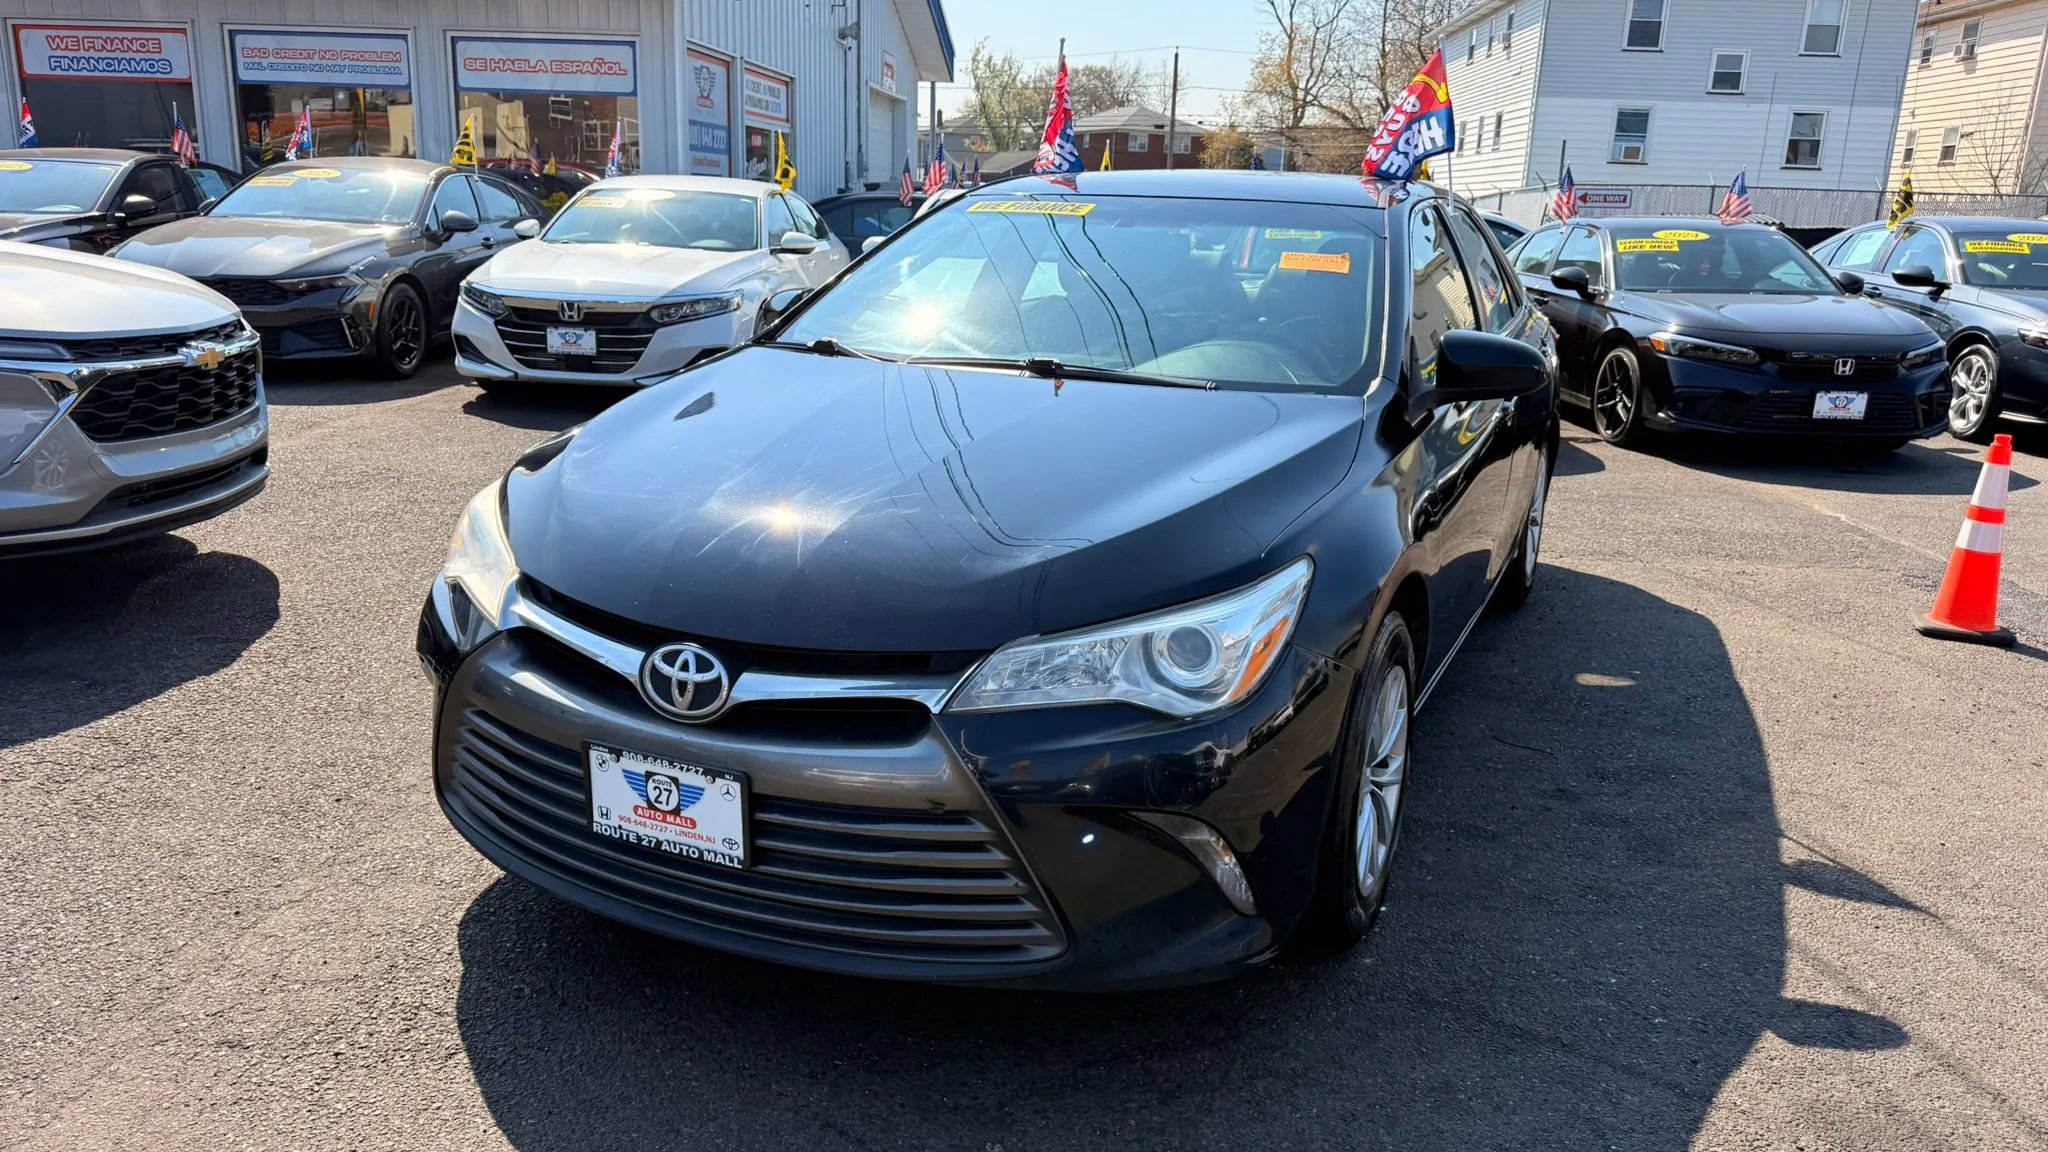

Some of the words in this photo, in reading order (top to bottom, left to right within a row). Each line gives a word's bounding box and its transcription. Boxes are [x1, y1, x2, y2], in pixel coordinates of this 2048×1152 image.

[46, 35, 80, 51] WE
[82, 36, 161, 54] FINANCE
[242, 47, 269, 58] BAD
[271, 48, 316, 60] CREDIT
[319, 49, 338, 60] NO
[340, 50, 401, 62] PROBLEM
[48, 56, 173, 74] FINANCIAMOS
[243, 62, 266, 71] MAL
[267, 62, 308, 72] CREDITO
[309, 63, 325, 72] NO
[325, 64, 347, 73] HAY
[348, 64, 402, 75] PROBLEMA
[464, 57, 488, 71] SE
[489, 58, 548, 73] HABLA
[550, 58, 628, 76] ESPAÑOL
[975, 201, 1003, 210] WE
[1003, 202, 1085, 213] FINANCE
[1586, 194, 1605, 202] ONE
[1606, 194, 1625, 202] WAY
[590, 743, 609, 752] Linden
[622, 751, 704, 776] 908-648-2727
[652, 777, 673, 788] ROUTE
[653, 785, 673, 807] 27
[618, 814, 668, 833] 908-648-2727
[637, 807, 663, 820] AUTO
[666, 814, 694, 828] MALL
[593, 822, 638, 844] ROUTE
[641, 834, 657, 848] 27
[661, 840, 699, 858] AUTO
[703, 850, 743, 869] MALL
